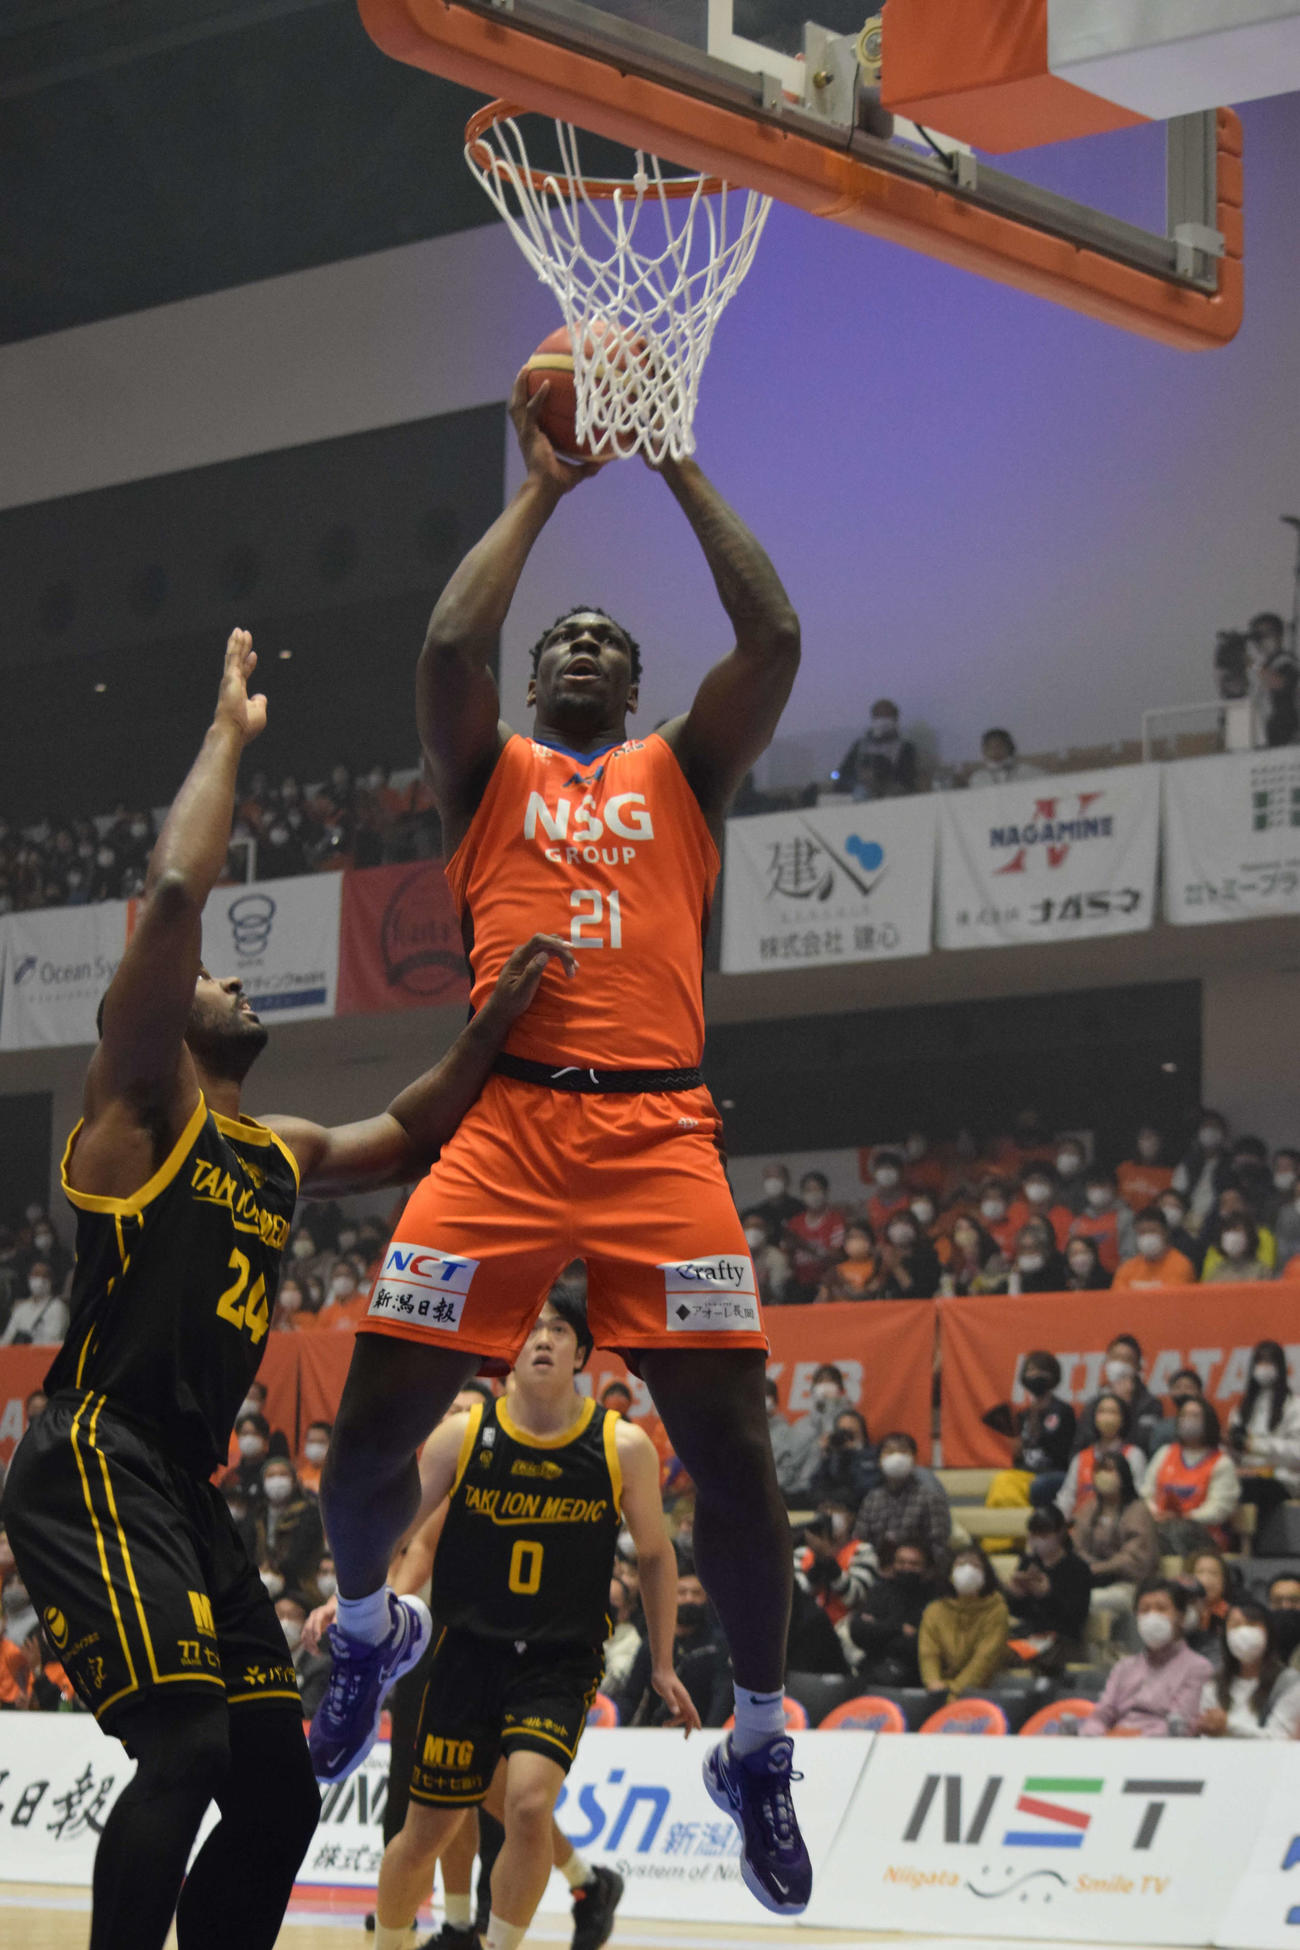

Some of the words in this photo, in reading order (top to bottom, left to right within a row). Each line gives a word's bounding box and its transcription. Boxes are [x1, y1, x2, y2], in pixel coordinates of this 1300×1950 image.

[524, 791, 654, 841] NSG
[989, 815, 1113, 848] NAGAMINE
[545, 846, 636, 865] GROUP
[570, 889, 622, 948] 21
[387, 1251, 467, 1281] NCT
[676, 1259, 744, 1287] Crafty
[216, 1247, 269, 1345] 24
[373, 1288, 456, 1323] 新潟日報
[541, 1496, 608, 1523] MEDIC
[508, 1539, 544, 1595] 0
[423, 1733, 474, 1768] MTG
[0, 1762, 115, 1840] 日報
[902, 1773, 1205, 1850] NST
[615, 1858, 684, 1878] System
[688, 1863, 708, 1881] of
[883, 1863, 960, 1890] Niigata
[1074, 1874, 1134, 1895] Smile
[1140, 1875, 1172, 1896] TV
